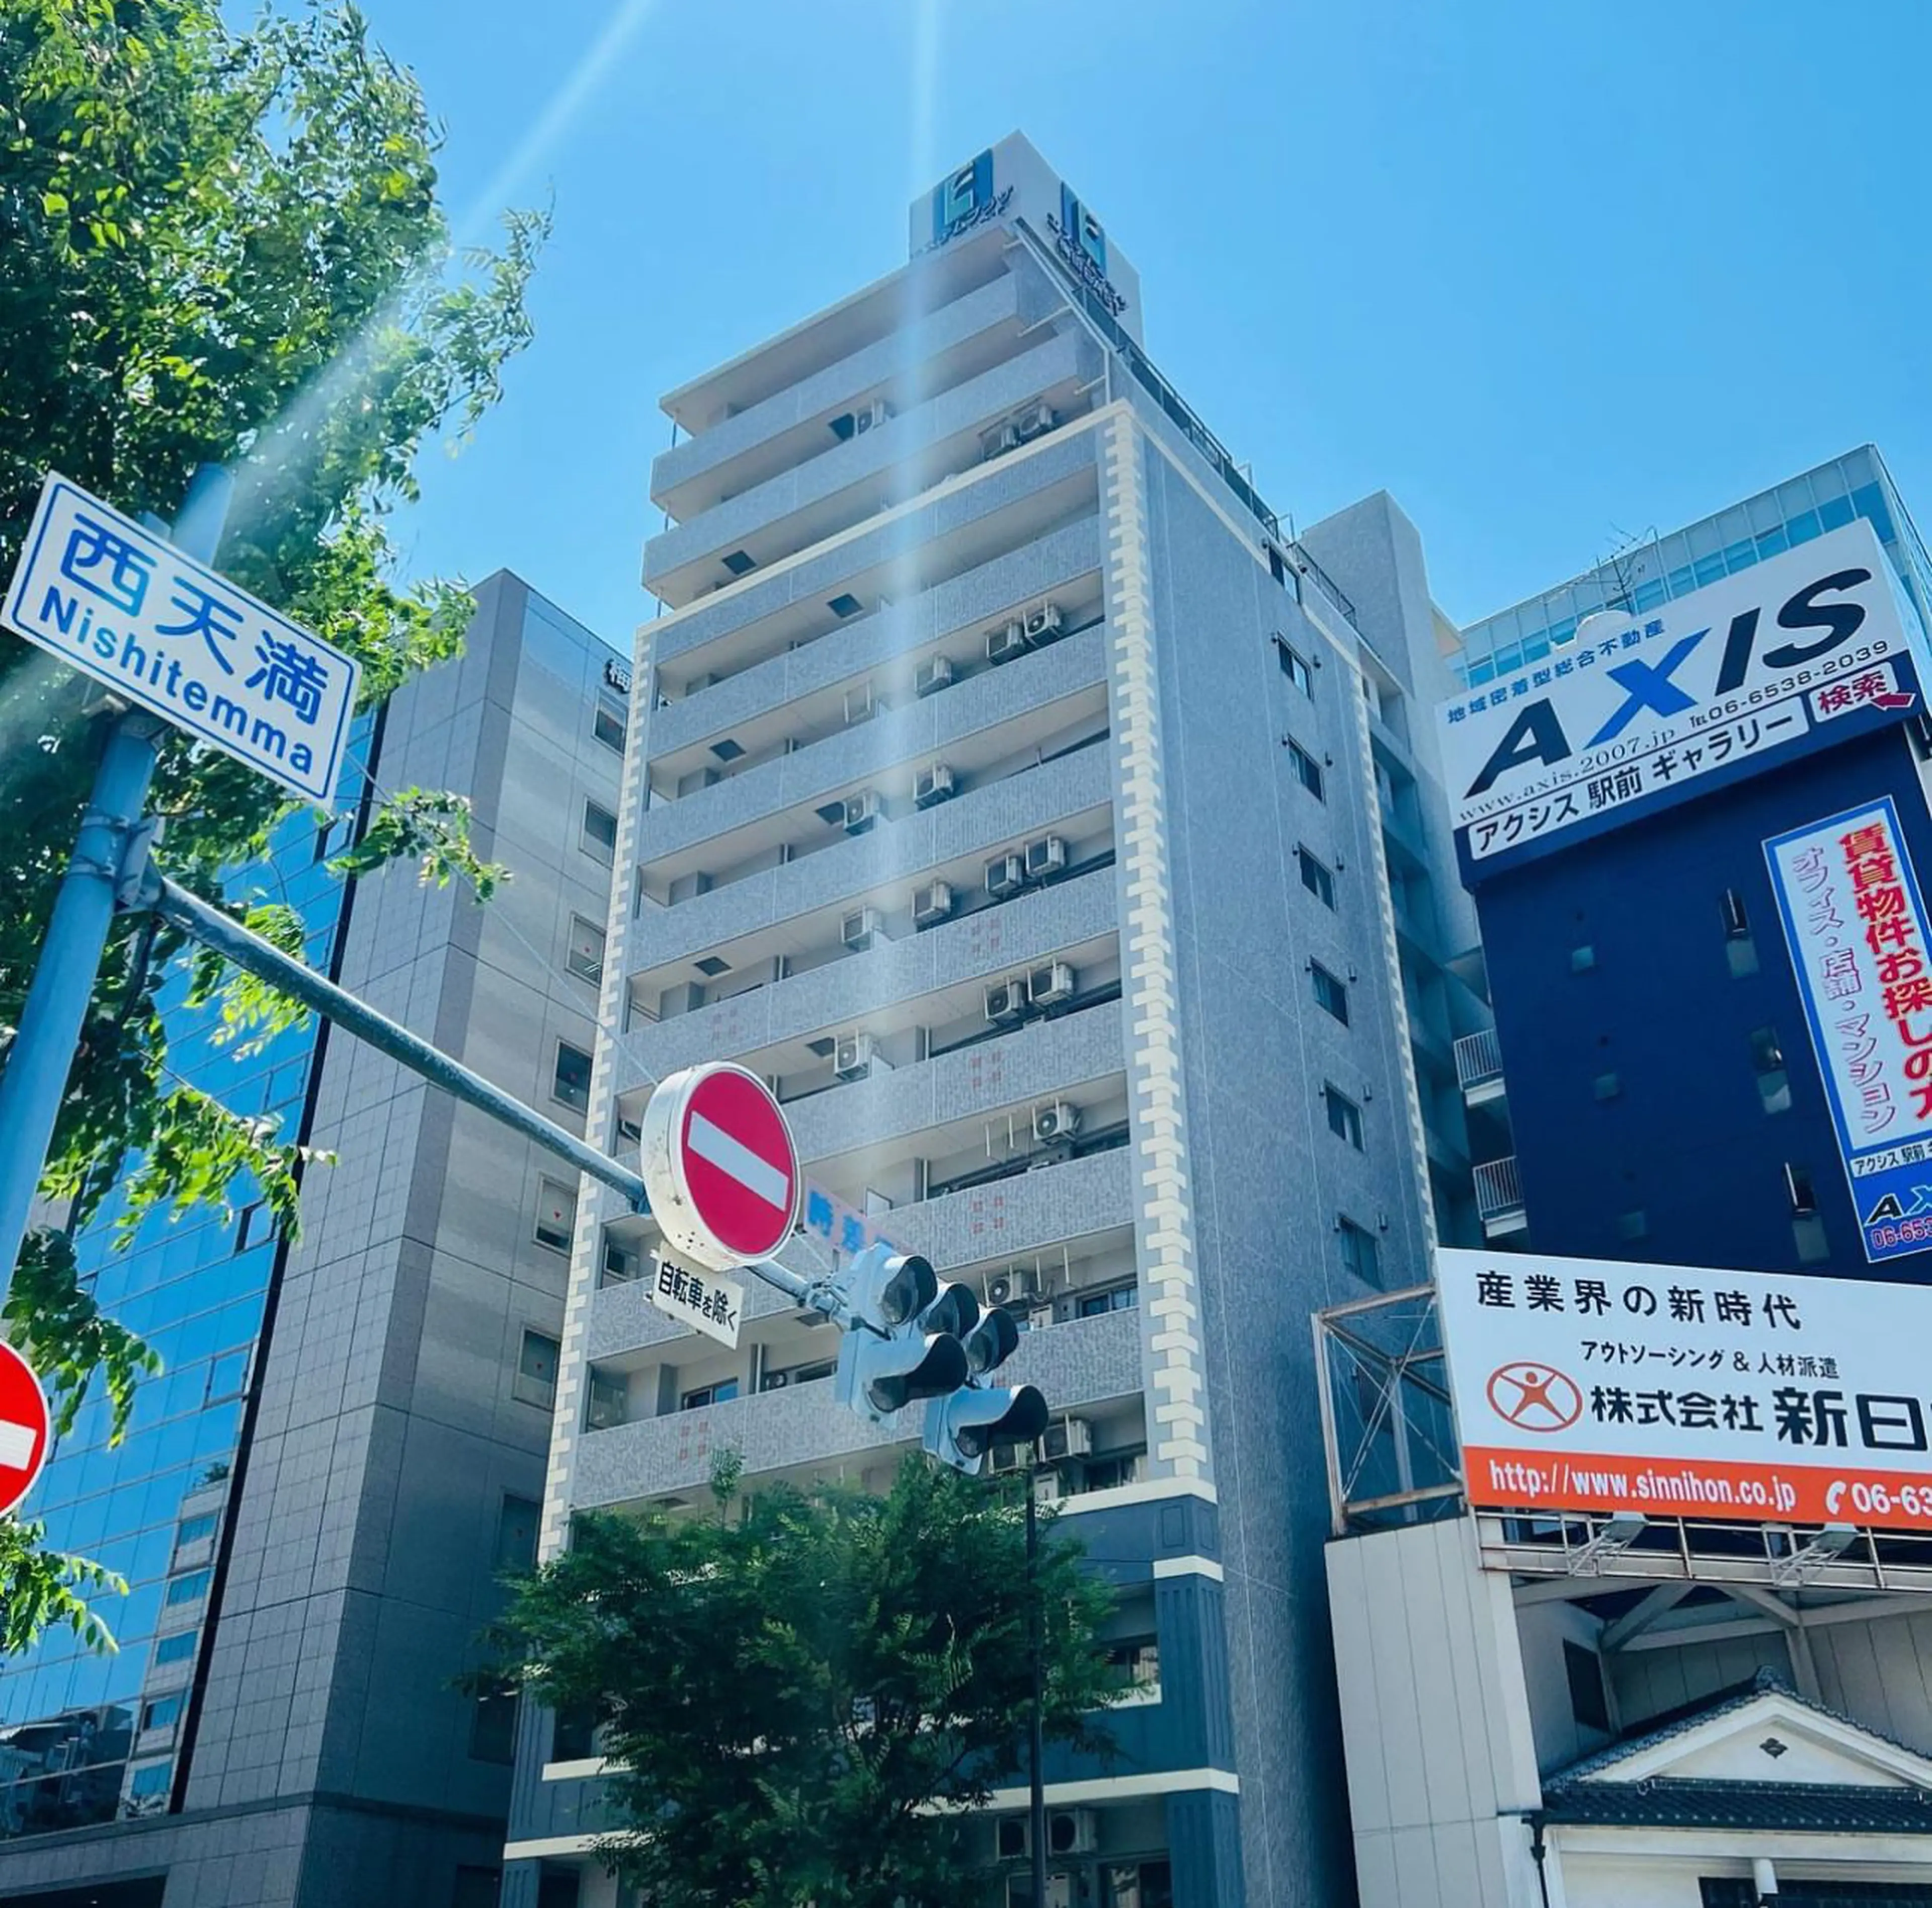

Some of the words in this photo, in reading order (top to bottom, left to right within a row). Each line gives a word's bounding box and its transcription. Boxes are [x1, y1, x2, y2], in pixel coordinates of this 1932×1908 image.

[60, 513, 328, 726] 西天満
[40, 586, 313, 774] Nishitemma
[1448, 618, 1665, 723] 地域密着型総合不動産
[1463, 568, 1872, 799] AXIS
[1476, 793, 1579, 852] アクシス
[1588, 766, 1642, 809] 駅前
[1652, 716, 1793, 781] ギャラリー
[1817, 670, 1887, 714] 検索
[1855, 1151, 1899, 1176] アクシス
[659, 1260, 737, 1331] 自転車を除く
[1476, 1270, 1801, 1330] 産業界の新時代
[1580, 1341, 1725, 1370] アウトソーシング
[1733, 1352, 1750, 1372] &
[1757, 1352, 1840, 1379] 人材派遣
[1489, 1459, 1797, 1513] http://www.sinnihon.co.jp
